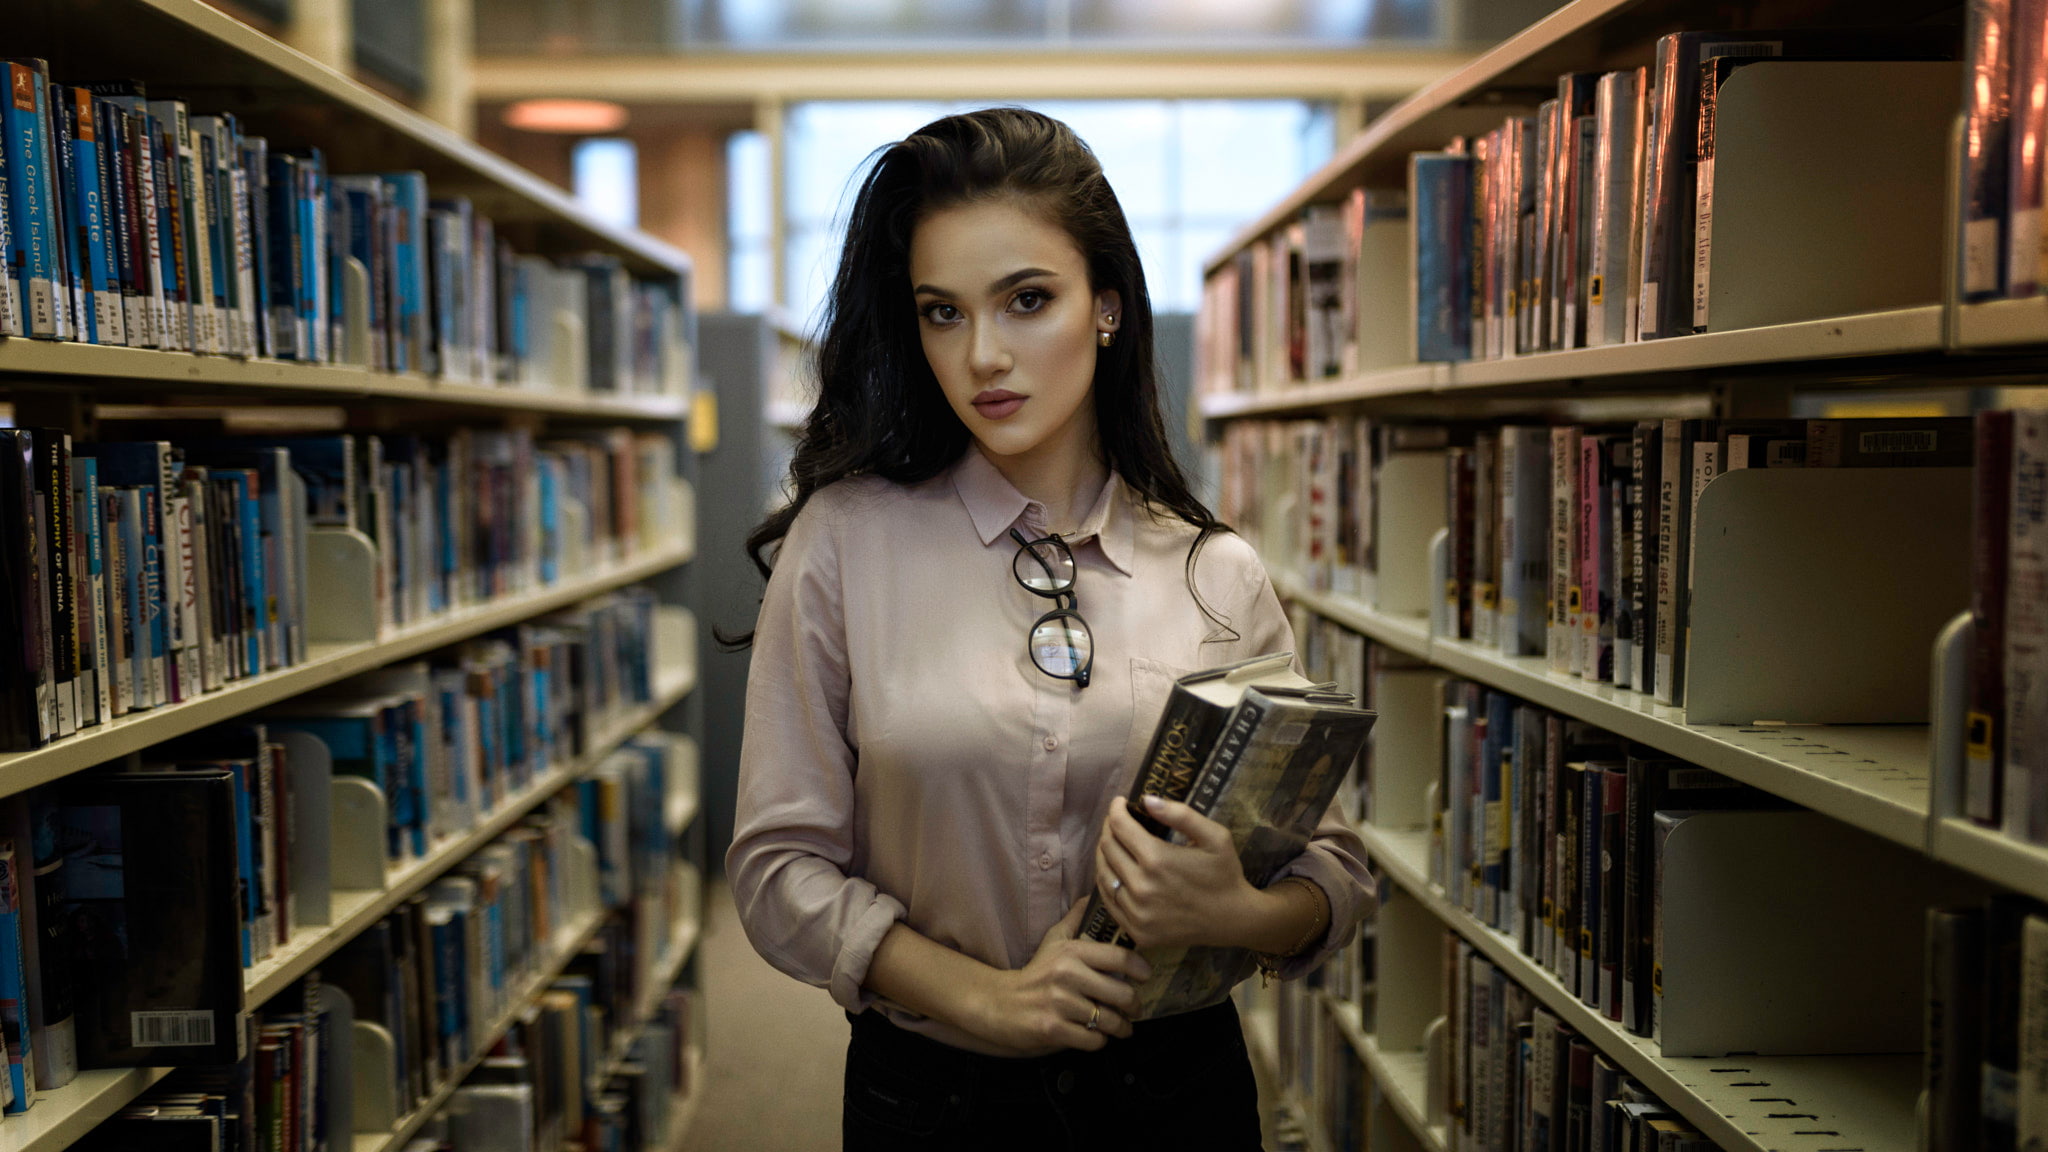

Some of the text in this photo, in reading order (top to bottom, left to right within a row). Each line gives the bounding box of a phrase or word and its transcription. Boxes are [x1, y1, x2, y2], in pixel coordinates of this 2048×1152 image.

[23, 128, 34, 160] The
[61, 130, 70, 168] Crete
[26, 164, 39, 215] Greek
[88, 190, 101, 242] Crete
[97, 140, 116, 273] Southeastern Europe
[115, 150, 130, 269] Western Balkans
[1698, 192, 1711, 269] We Die Alone
[51, 442, 60, 466] THE
[1583, 447, 1593, 500] Women
[1632, 438, 1644, 480] LOST
[51, 469, 62, 549] GEOGRAPHY
[163, 452, 174, 516] CHINA
[1632, 484, 1643, 504] IN
[1583, 503, 1593, 561] Overseas
[1659, 481, 1672, 563] SWANSONG
[55, 552, 63, 570] OF
[146, 544, 161, 620] CHINA
[180, 504, 196, 608] CHINA
[1632, 508, 1644, 611] SHANGRI-LA
[1658, 566, 1669, 595] 1945
[56, 572, 65, 612] CHINA
[1139, 718, 1190, 806] SOMERS
[1165, 748, 1197, 801] ANN
[1202, 706, 1258, 798] CHARLES
